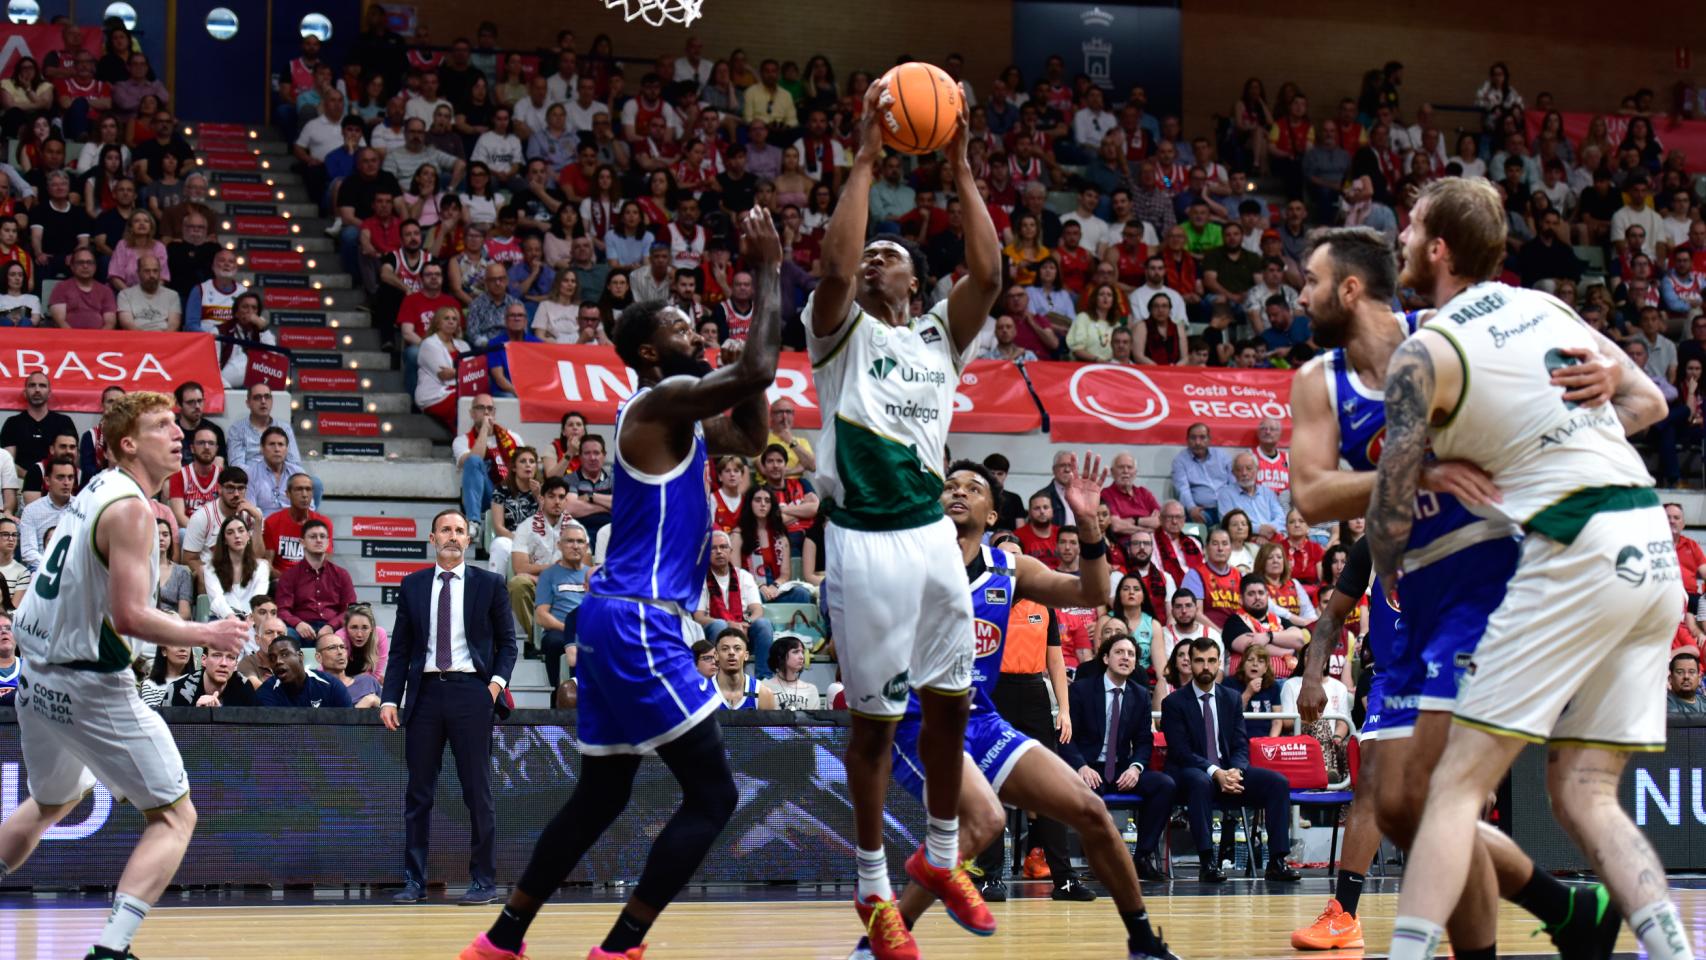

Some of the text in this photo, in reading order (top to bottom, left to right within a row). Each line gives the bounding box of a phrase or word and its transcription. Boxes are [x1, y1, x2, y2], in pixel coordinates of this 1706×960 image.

[252, 361, 283, 378] MÓDULO
[462, 369, 486, 384] MÓDULO
[901, 367, 946, 389] Unicaja
[1183, 383, 1228, 397] Costa
[885, 399, 939, 424] málaga
[1257, 469, 1289, 483] UCAM
[35, 534, 73, 600] 9
[33, 682, 72, 705] COSTA
[33, 694, 73, 716] DEL SOL
[1280, 743, 1307, 752] UCAM
